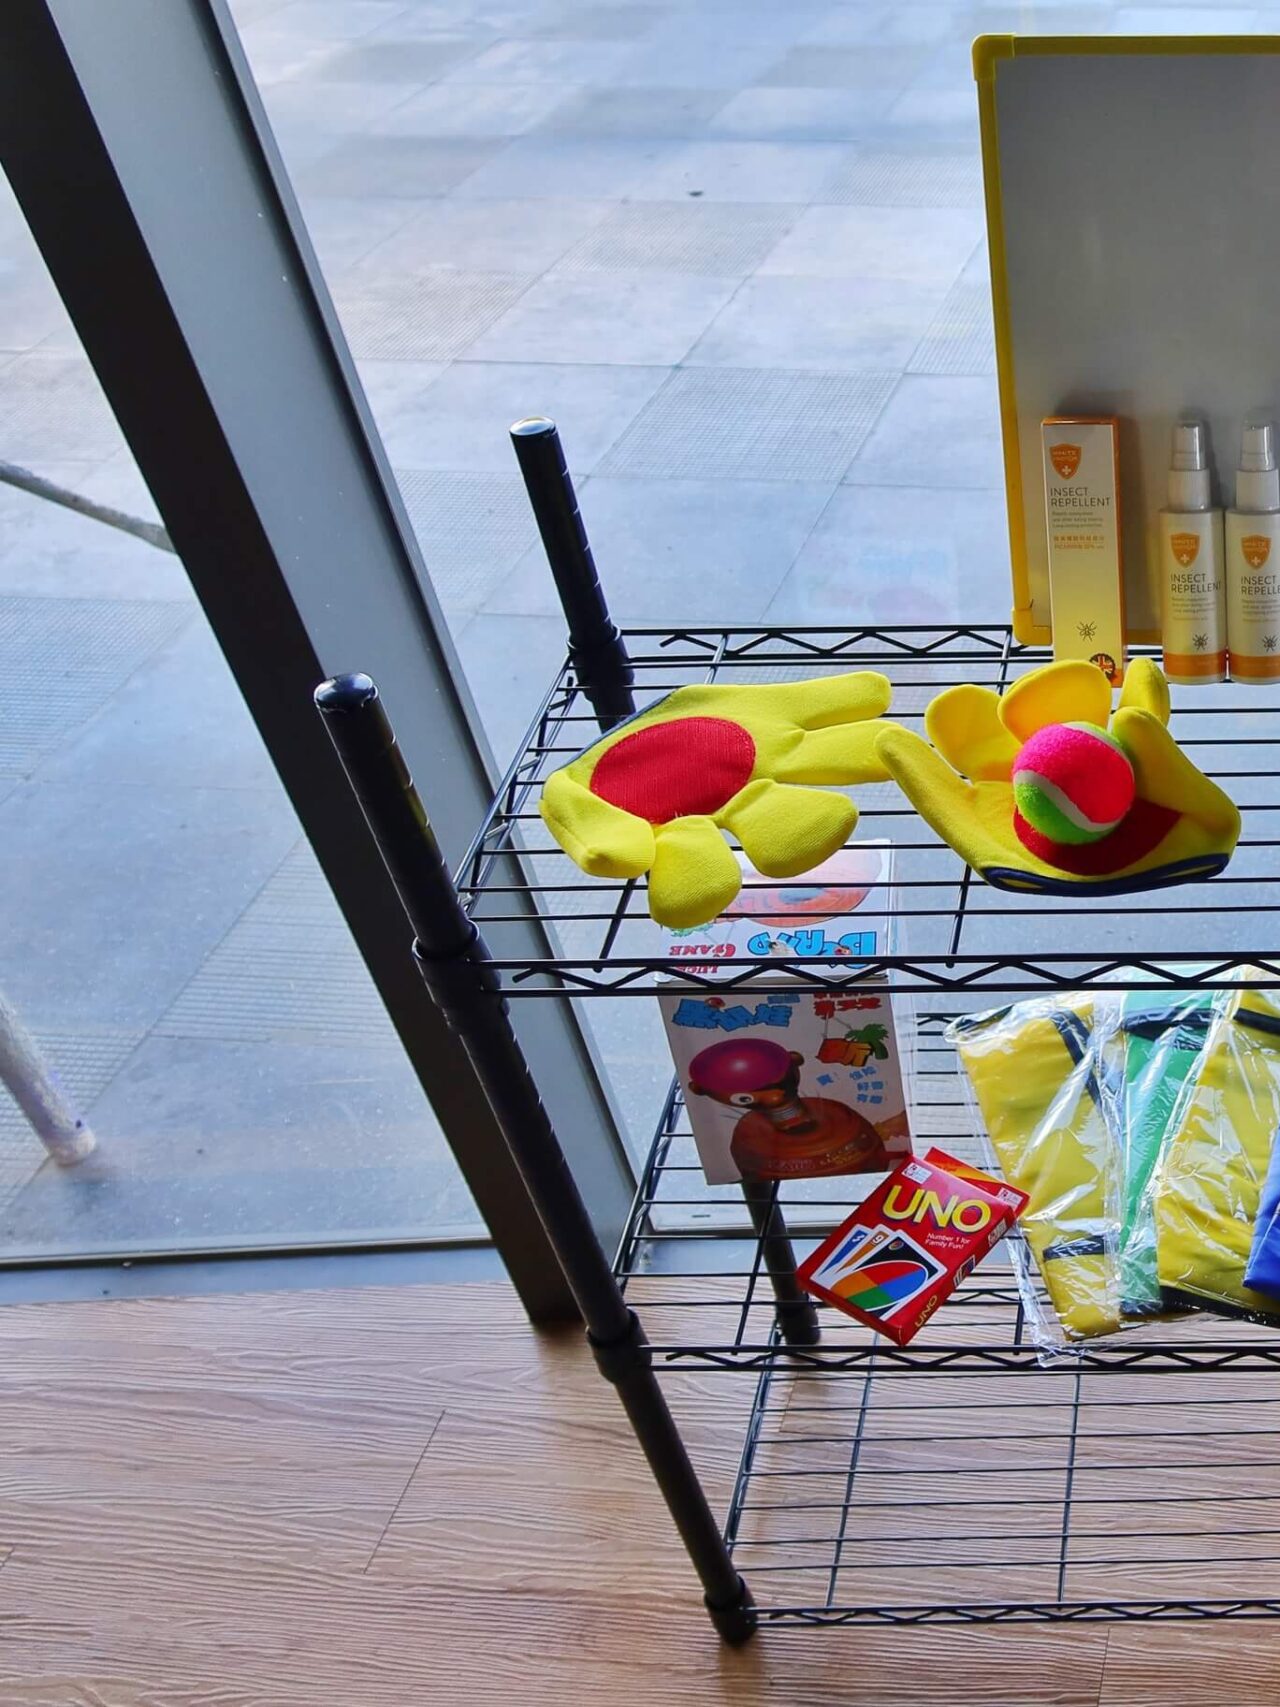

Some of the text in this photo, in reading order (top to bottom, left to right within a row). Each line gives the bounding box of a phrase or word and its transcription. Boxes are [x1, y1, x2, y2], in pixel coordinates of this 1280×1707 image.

[1050, 487, 1088, 497] INSECT
[1050, 497, 1111, 508] REPELLENT
[1170, 573, 1206, 584] INSECT
[1240, 575, 1276, 586] INSECT
[1171, 581, 1222, 594] REPELLENT
[882, 1184, 992, 1234] UNO
[925, 1239, 965, 1250] Family Fun!
[927, 1233, 954, 1242] Number
[960, 1237, 971, 1245] for
[914, 1295, 938, 1328] UNO
